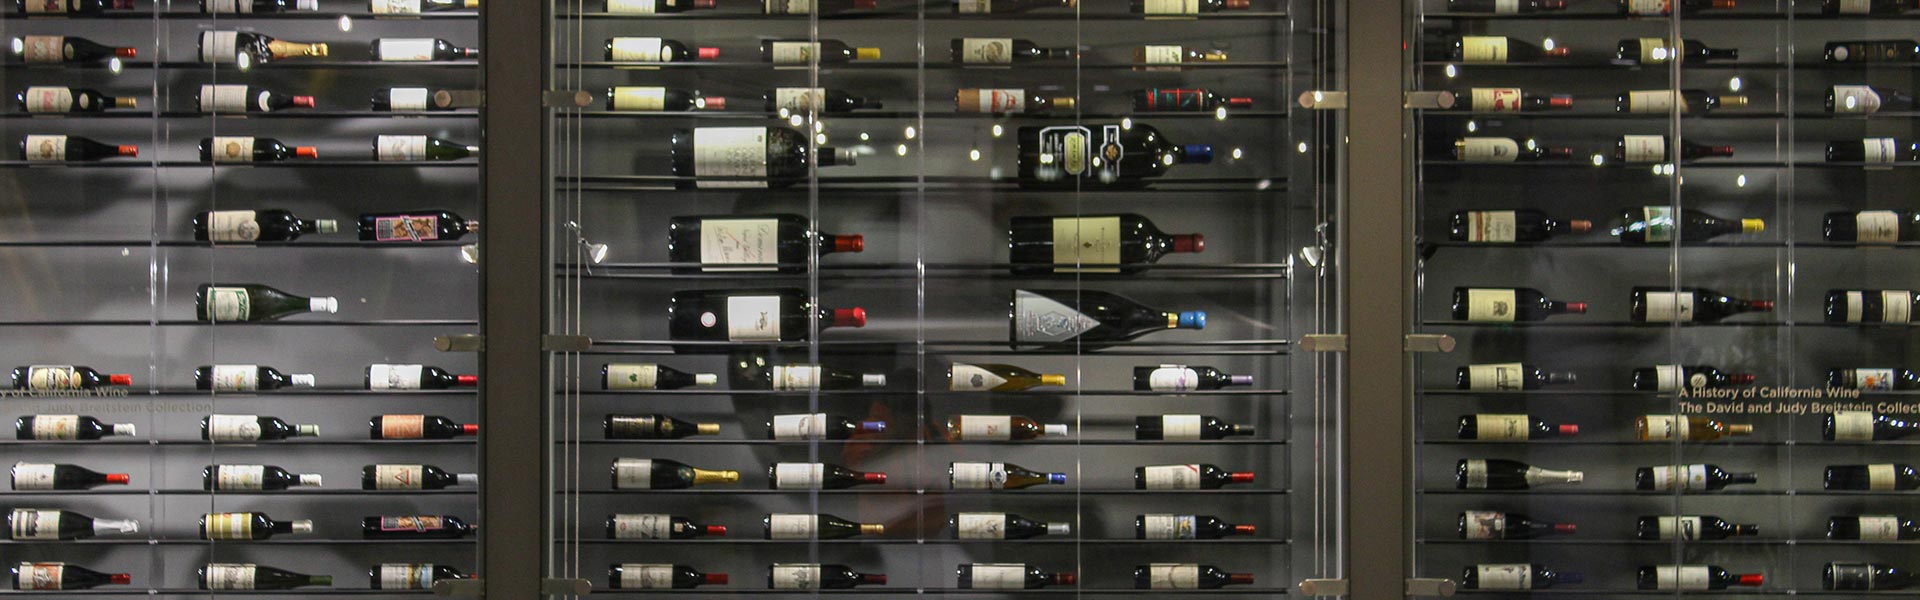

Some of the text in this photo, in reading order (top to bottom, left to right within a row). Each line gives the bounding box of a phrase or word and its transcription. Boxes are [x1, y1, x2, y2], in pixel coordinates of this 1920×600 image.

[29, 386, 91, 398] California
[95, 386, 129, 398] Wine
[1678, 386, 1860, 401] A History of California Wine
[145, 401, 212, 412] Collection
[1679, 402, 1702, 413] The
[1706, 401, 1744, 413] David
[1748, 401, 1772, 413] and
[1776, 401, 1807, 416] Judy
[1811, 401, 1873, 414] Breitstein
